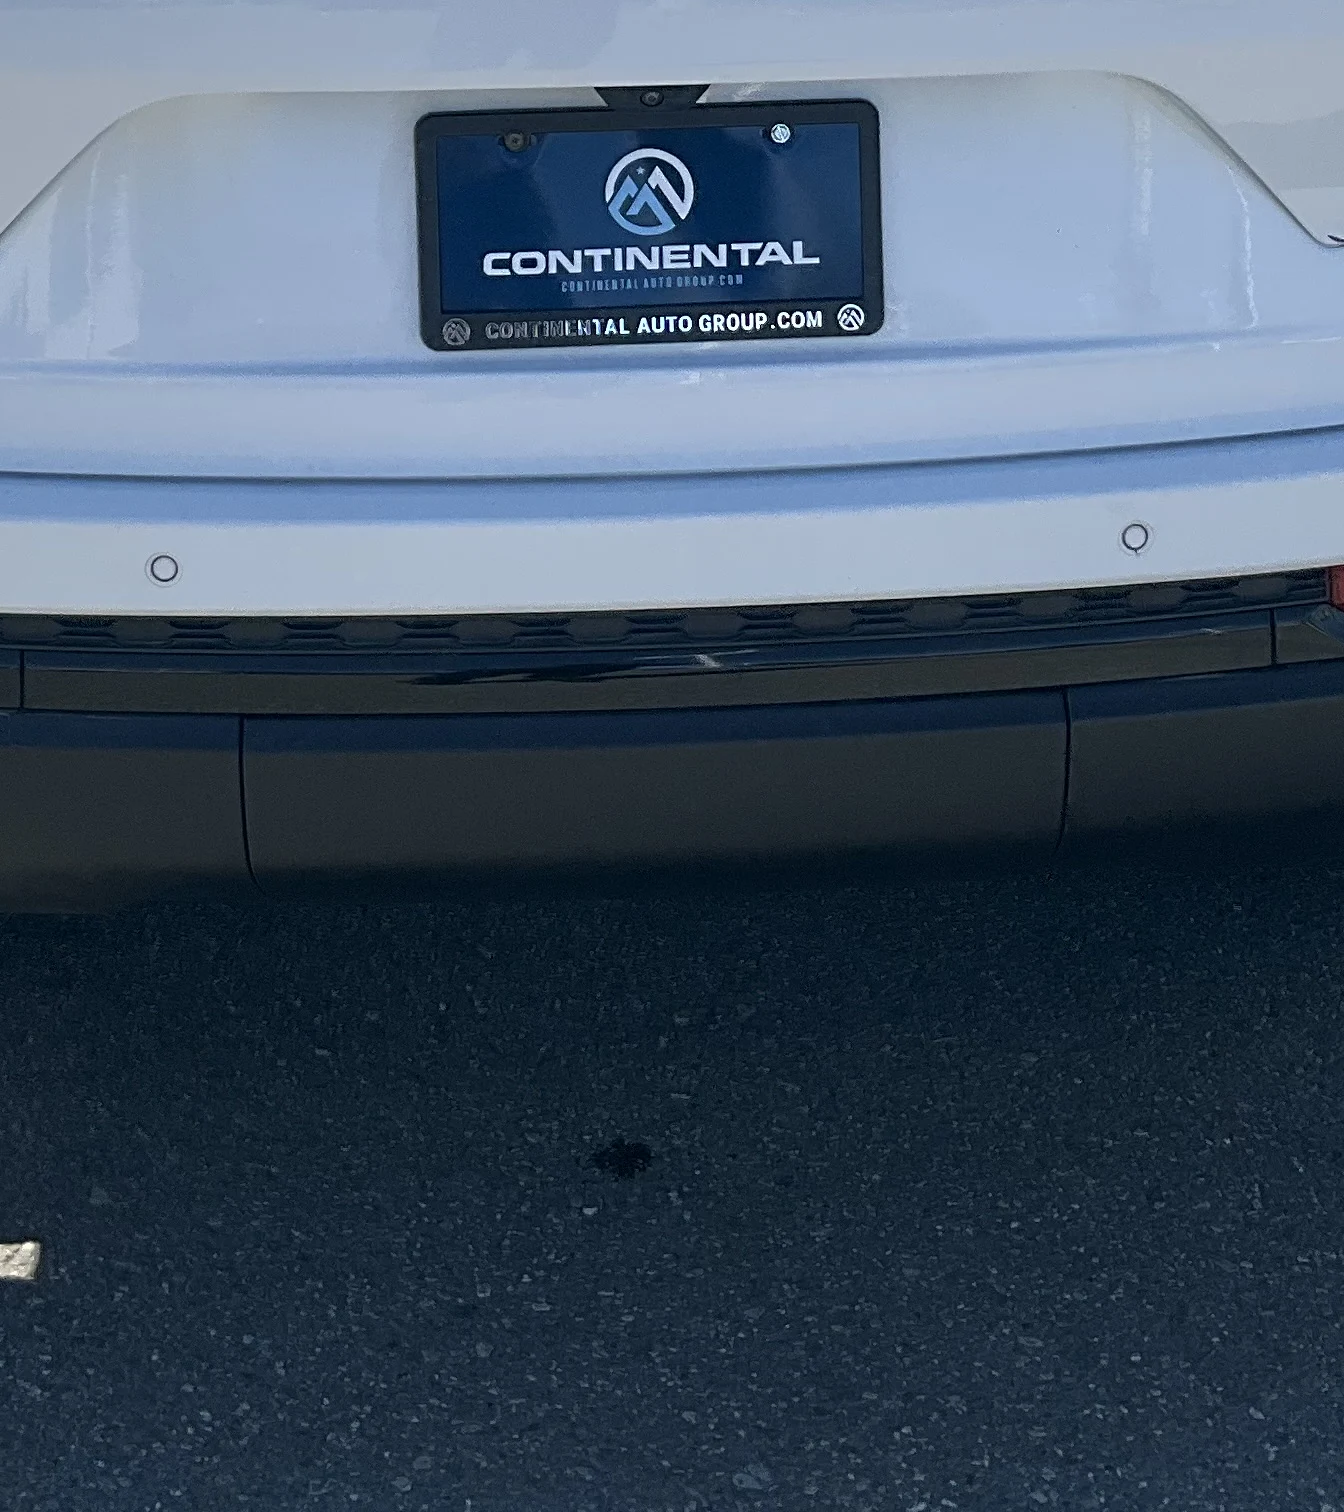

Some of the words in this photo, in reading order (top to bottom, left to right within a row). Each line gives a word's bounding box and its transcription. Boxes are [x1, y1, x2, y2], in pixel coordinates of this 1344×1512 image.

[482, 240, 821, 277] CONTINENTAL
[561, 277, 639, 293] CONTINENTAL
[643, 275, 672, 289] AUTO
[485, 318, 631, 339] CONTINENTAL
[636, 315, 693, 334] AUTO
